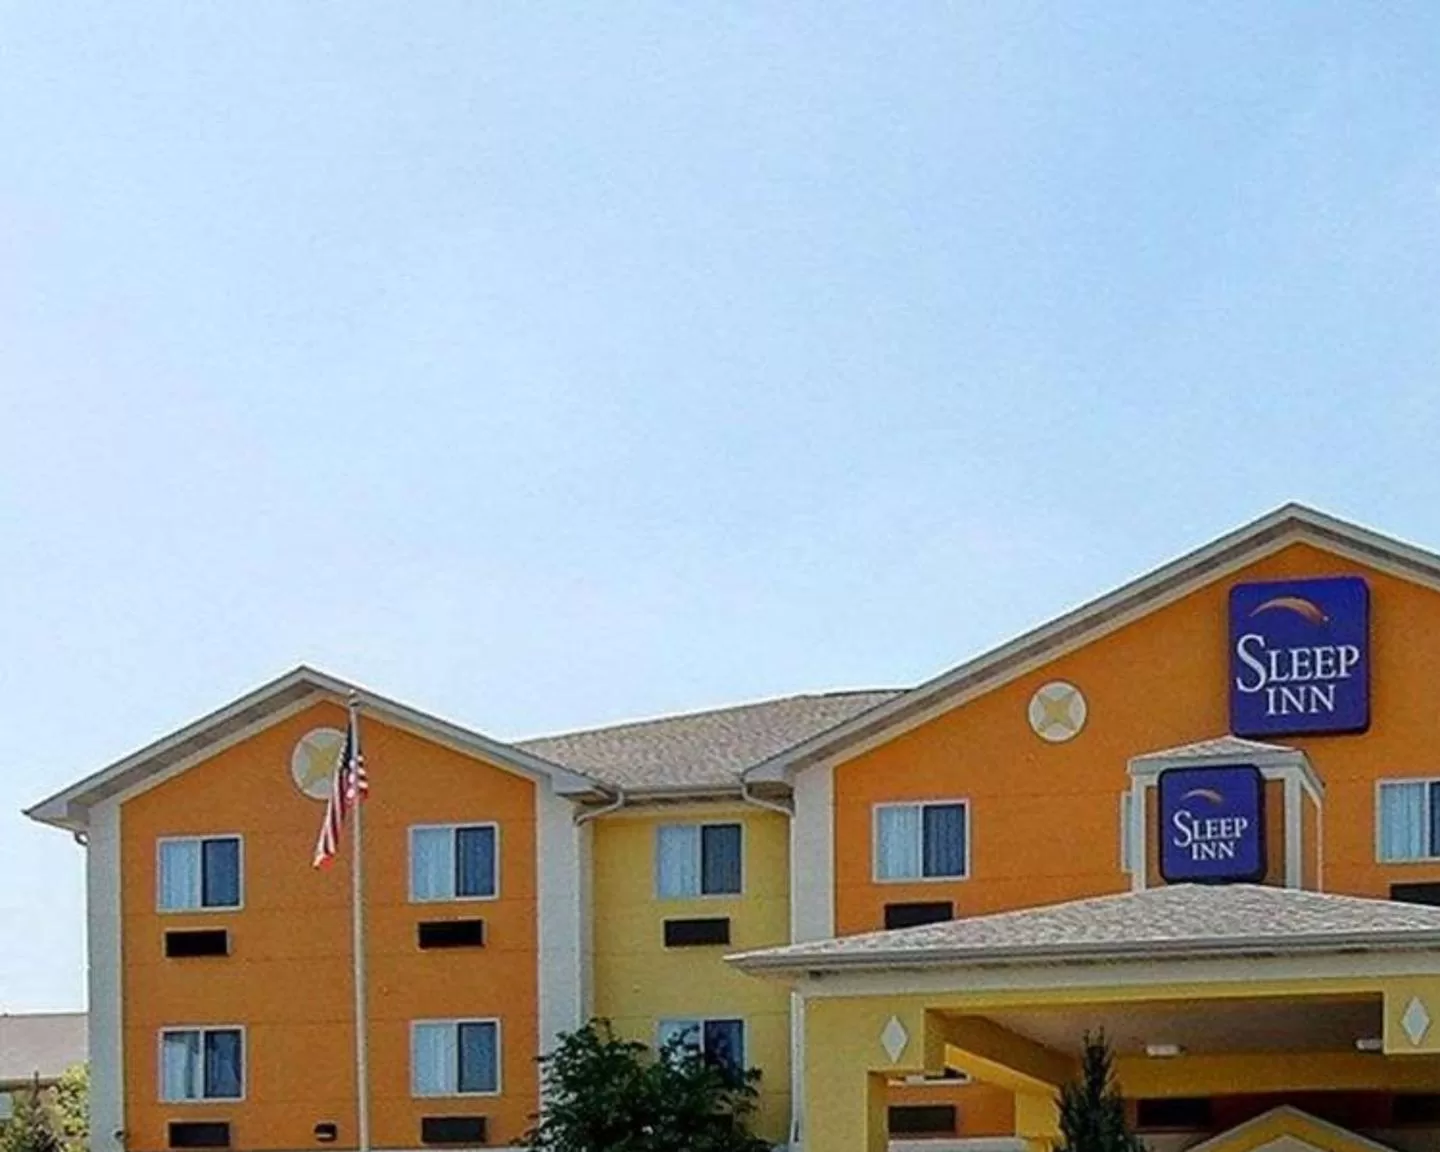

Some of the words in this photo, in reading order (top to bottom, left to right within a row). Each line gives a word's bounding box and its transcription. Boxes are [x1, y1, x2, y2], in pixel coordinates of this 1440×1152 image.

[1235, 633, 1360, 693] SLEEP
[1266, 684, 1335, 715] INN
[1172, 809, 1248, 847] SLEEP
[1191, 841, 1235, 860] INN
